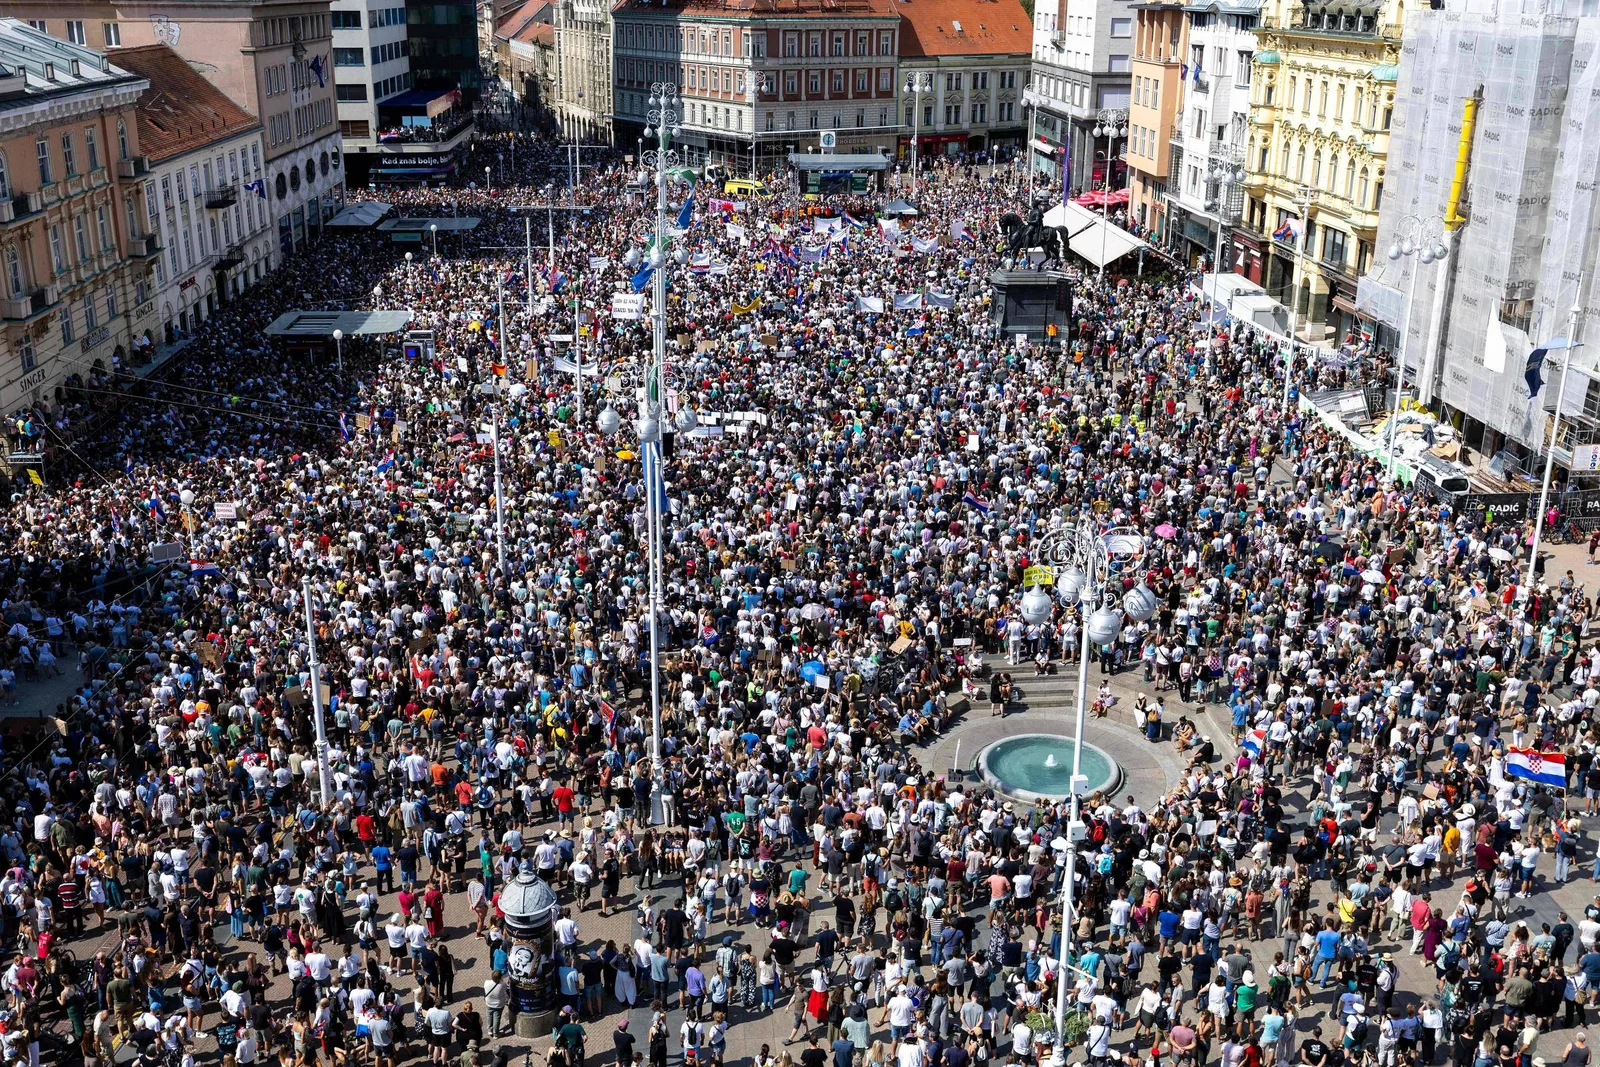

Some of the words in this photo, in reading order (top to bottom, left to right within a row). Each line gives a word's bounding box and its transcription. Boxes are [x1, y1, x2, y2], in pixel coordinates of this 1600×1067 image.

[1521, 17, 1540, 28] RADIĆ
[1507, 104, 1525, 117] RADIĆ
[1529, 105, 1561, 117] RADIĆ
[1484, 129, 1500, 141] RADIĆ
[764, 144, 784, 152] ZAKS
[418, 156, 439, 165] bolje,
[1495, 190, 1513, 203] RADIĆ
[1472, 213, 1488, 226] RADIĆ
[135, 301, 153, 320] SINGER
[20, 368, 47, 393] SINGER
[1453, 371, 1467, 385] RADIĆ
[1489, 502, 1520, 512] RADIĆ
